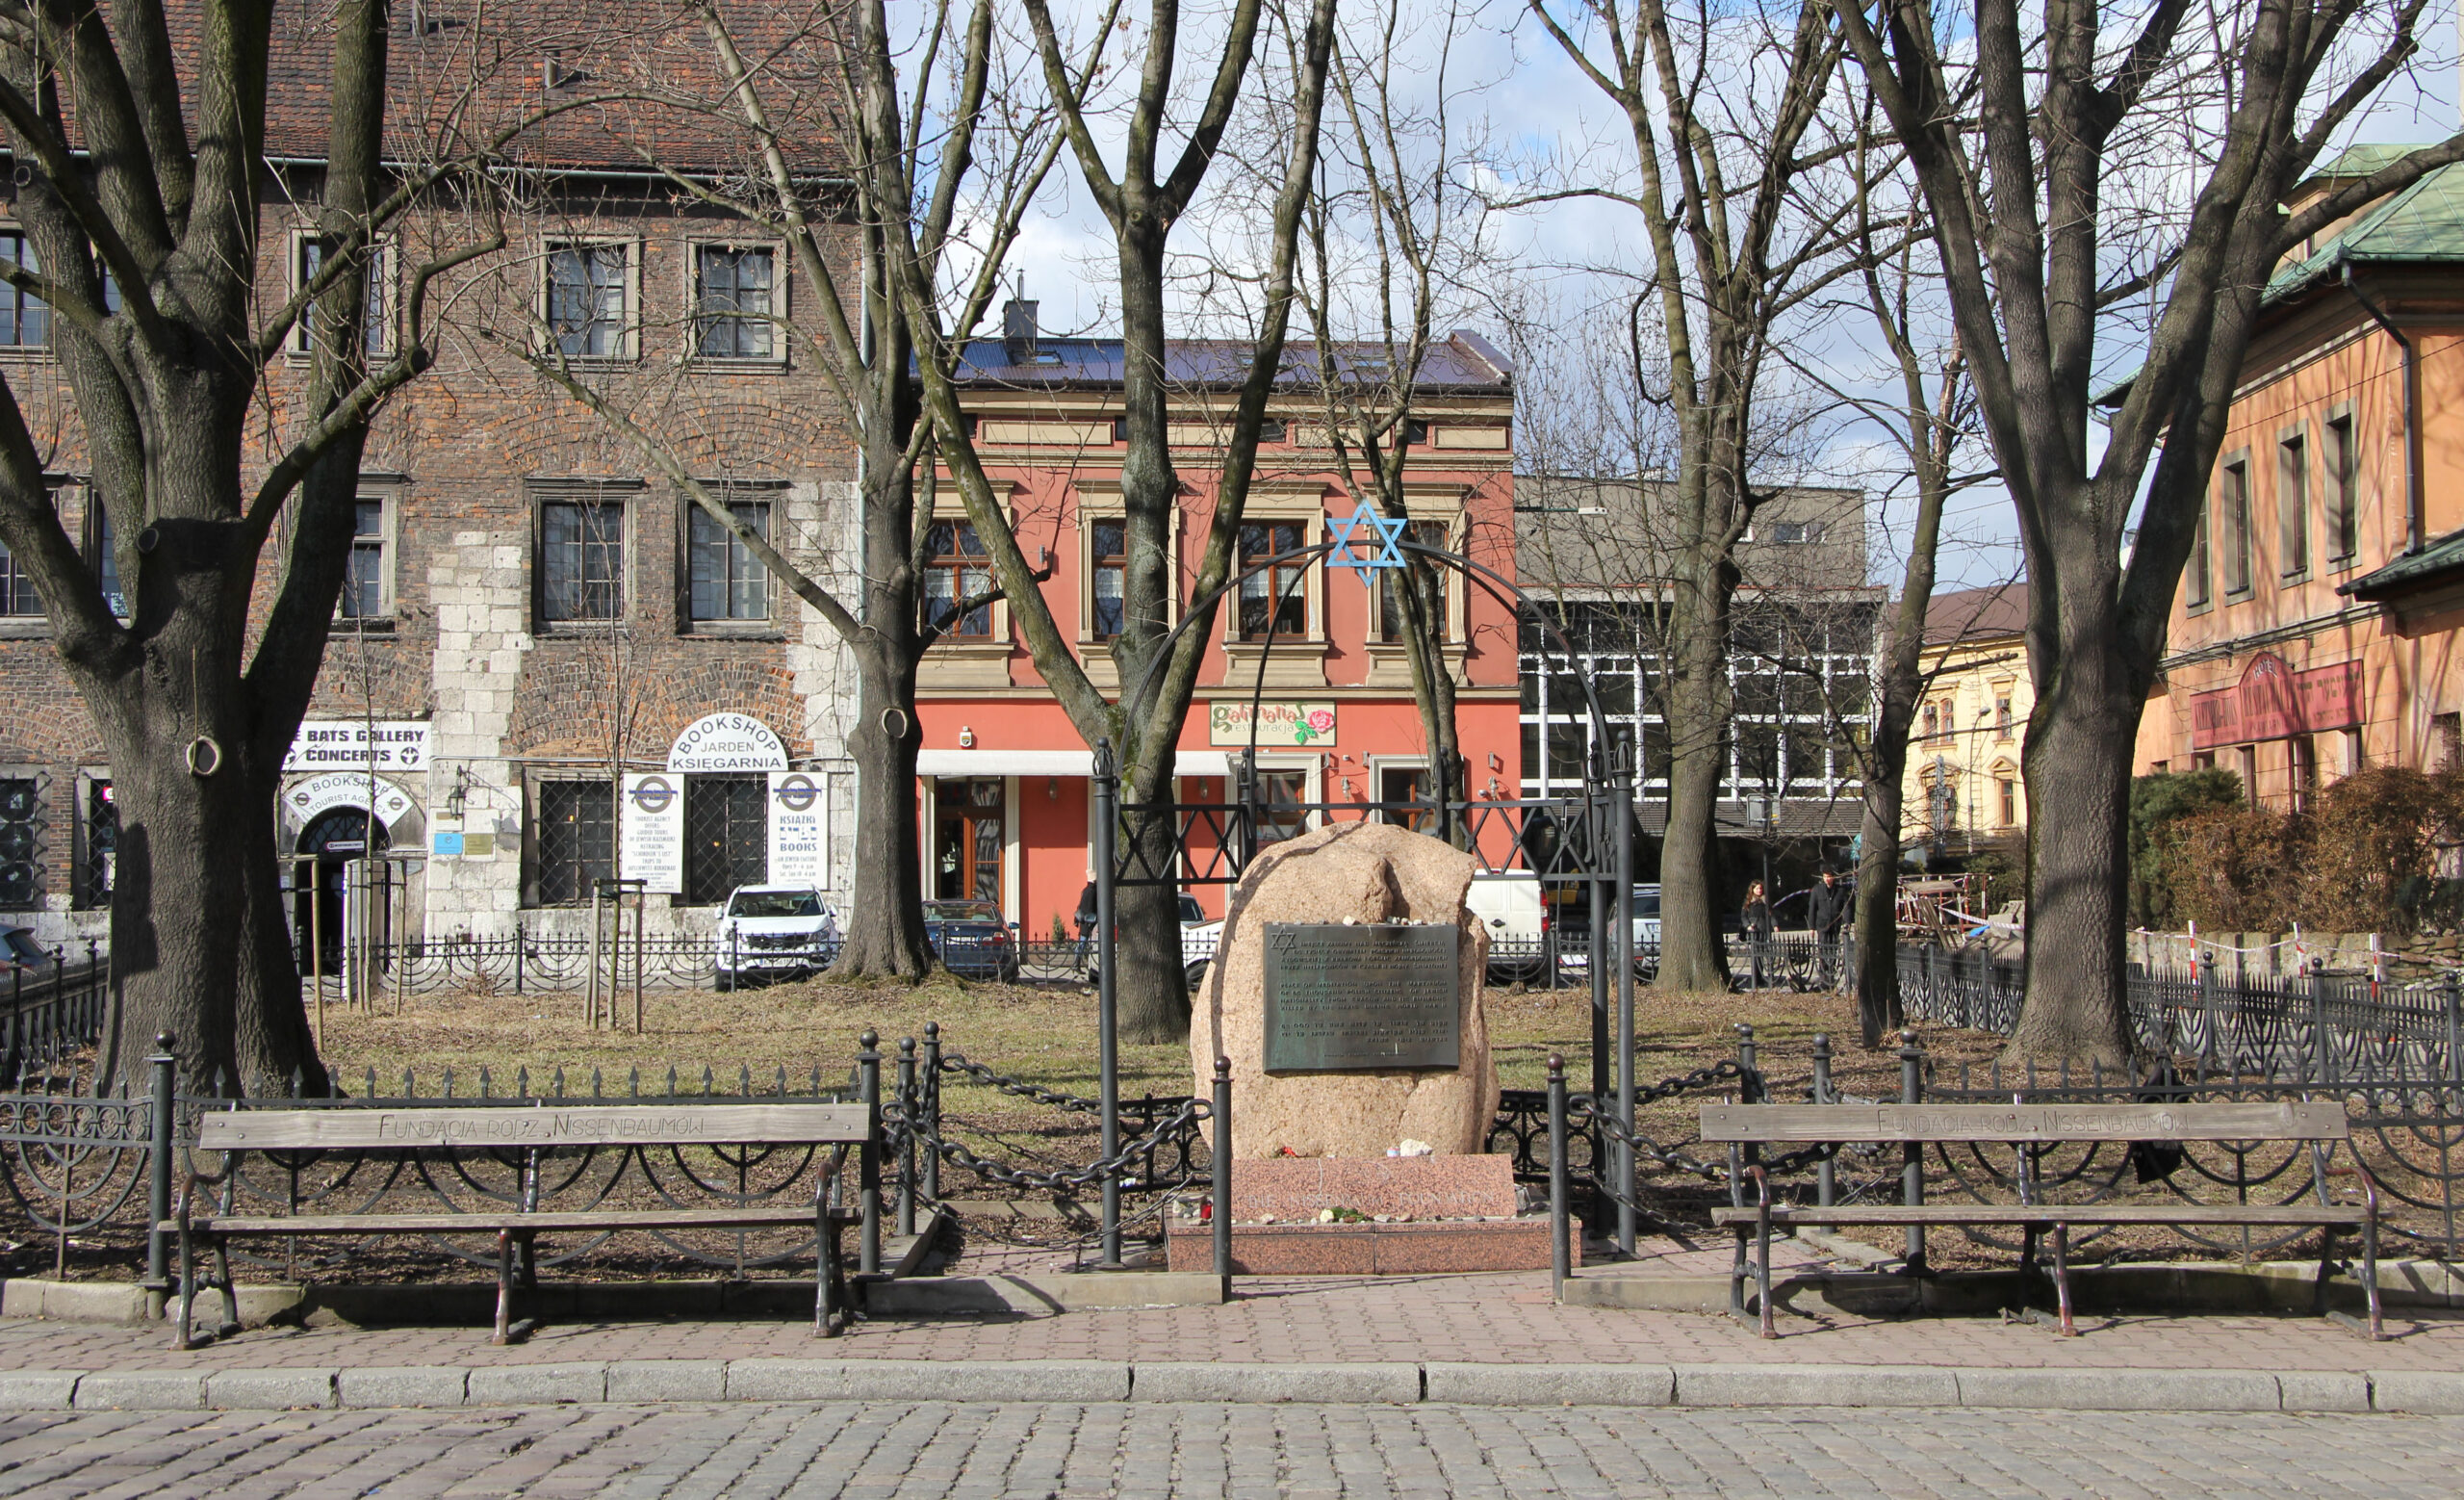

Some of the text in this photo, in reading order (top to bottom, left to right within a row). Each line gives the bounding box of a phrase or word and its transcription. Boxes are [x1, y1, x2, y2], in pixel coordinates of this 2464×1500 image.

[2253, 659, 2278, 681] HOTEL
[1232, 723, 1295, 735] resturacja
[308, 730, 349, 742] BATS
[356, 730, 424, 742] GALLERY
[678, 717, 778, 755] BOOKSHOP
[701, 741, 755, 752] JARDEN
[306, 749, 392, 762] CONCERTS
[673, 758, 781, 771] KSIĘGARNIA
[312, 777, 389, 794] BOOKSHOP
[310, 793, 388, 815] TOURIST AGECY
[781, 842, 817, 852] BOOKS
